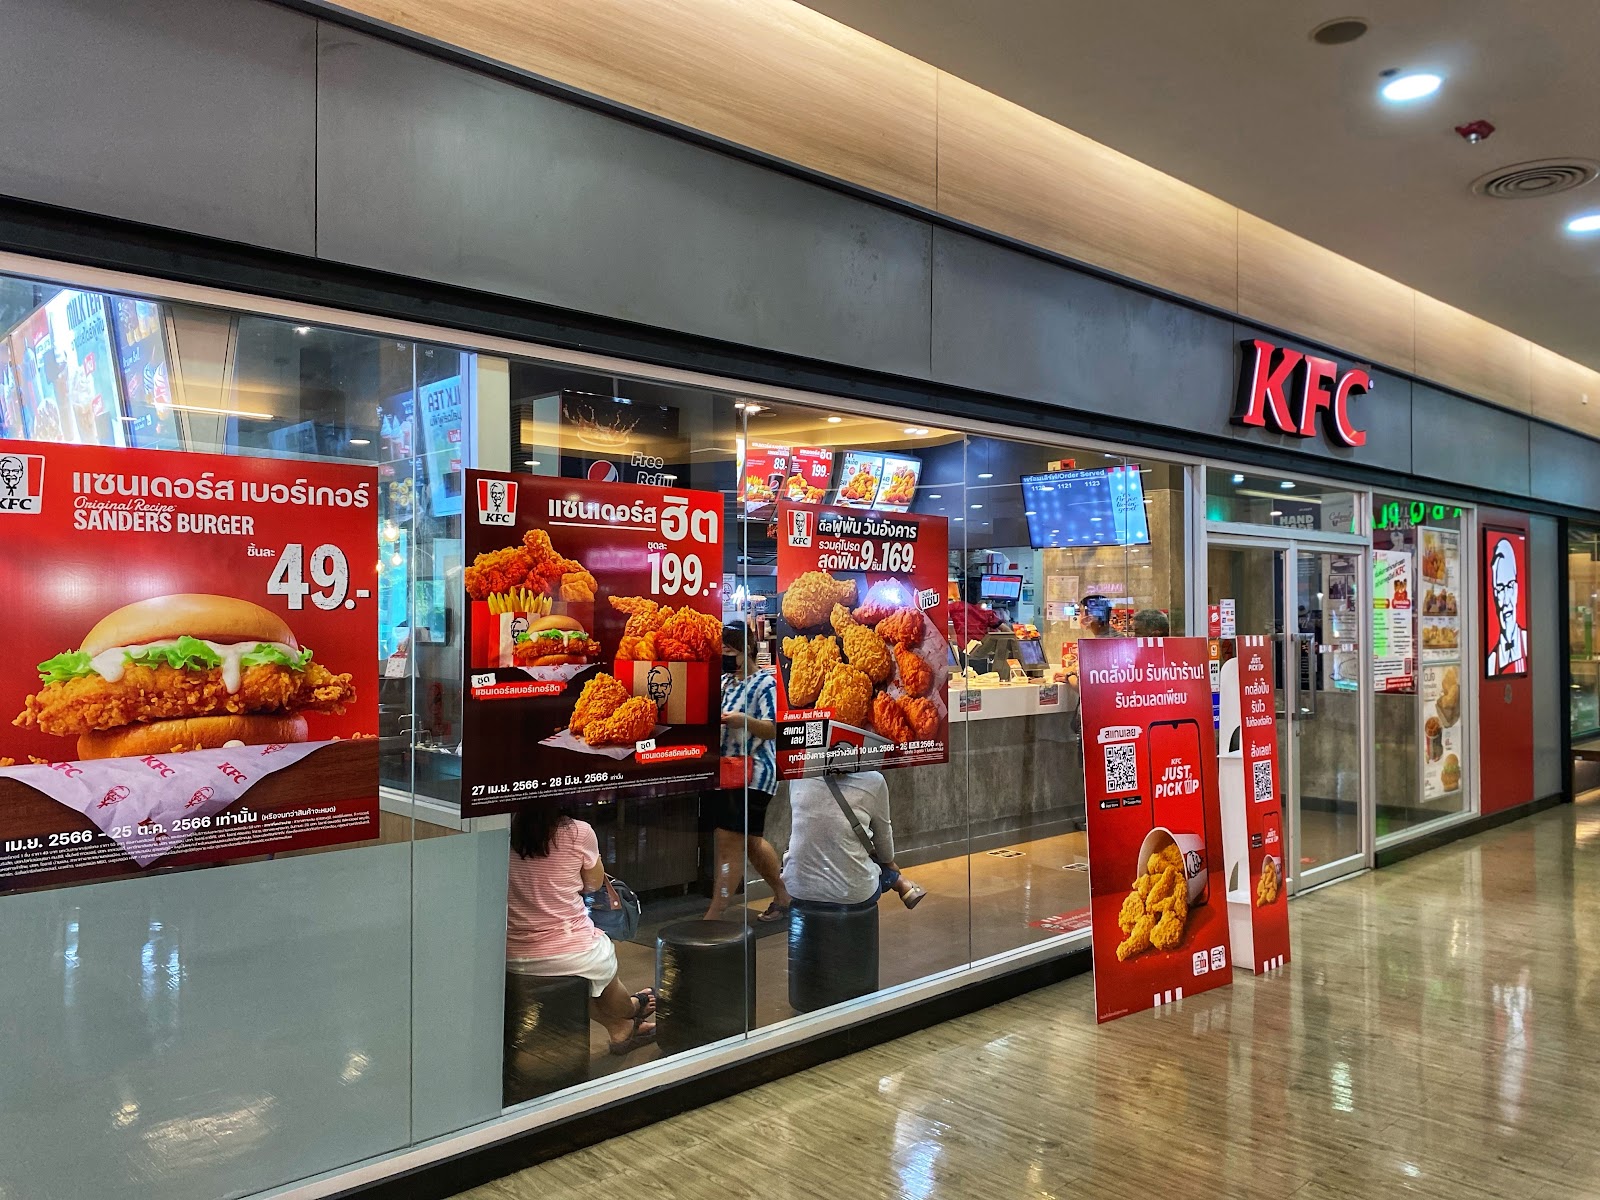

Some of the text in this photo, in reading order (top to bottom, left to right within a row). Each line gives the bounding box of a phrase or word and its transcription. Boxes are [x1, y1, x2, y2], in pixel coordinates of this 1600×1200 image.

[1243, 339, 1370, 447] KFC
[631, 451, 664, 469] Free
[811, 463, 830, 477] 199.-
[1080, 470, 1104, 478] Served
[637, 471, 674, 488] Refill
[73, 472, 369, 508] แซนเดอร์ส เบอร์เกอร์
[73, 496, 175, 515] Original Recipe
[73, 509, 254, 535] SANDERS BURGER
[485, 513, 510, 523] KFC
[548, 495, 718, 543] แซนเดอร์ส ฮิต
[1280, 514, 1314, 525] HAND
[863, 518, 917, 539] วันอังคาร
[647, 541, 667, 552] ชุดละ
[792, 536, 808, 545] KFC
[818, 538, 860, 554] รวมคู่โปรด
[818, 551, 859, 573] สุดฟิน
[860, 540, 874, 571] 9
[247, 543, 370, 610] ชิ้นละ 49.-
[647, 552, 717, 597] 199.-
[1089, 657, 1205, 685] กดสั่งปั๊บ รับหน้าร้าน!
[477, 676, 490, 686] ชุด
[475, 684, 560, 696] แซนเดอร์สเบอร์เกอร์ฮิต
[1115, 688, 1187, 709] รับส่วนลดเพียบ
[802, 711, 812, 719] Just
[813, 710, 824, 718] Pick
[1251, 699, 1265, 713] รับไว
[783, 726, 804, 735] สแกน
[1104, 728, 1136, 739] สแกนเลย
[641, 741, 651, 751] ชุด
[790, 736, 804, 745] เลย
[1250, 740, 1271, 758] สั่งเลย!
[788, 752, 825, 764] ทุกวันอังคาร
[826, 744, 859, 758] ระหว่างวันที่
[879, 744, 895, 753] 2566
[920, 740, 934, 748] 2566
[140, 755, 175, 778] KFC
[217, 762, 247, 784] KFC
[1161, 765, 1190, 782] JUST
[472, 785, 485, 796] 27
[487, 783, 510, 794] เม.ย.
[512, 780, 539, 792] 2566
[549, 777, 562, 788] 28
[584, 772, 608, 784] 2566
[1155, 781, 1182, 798] PICK
[5, 837, 43, 853] เม.ย.
[48, 830, 93, 847] 2566
[112, 825, 132, 839] 25
[137, 823, 167, 836] ต.ค.
[172, 817, 211, 832] 2566
[215, 807, 258, 827] เท่านั้น
[261, 805, 336, 821] (หรือจนกว่าสินค้าจะหมด)
